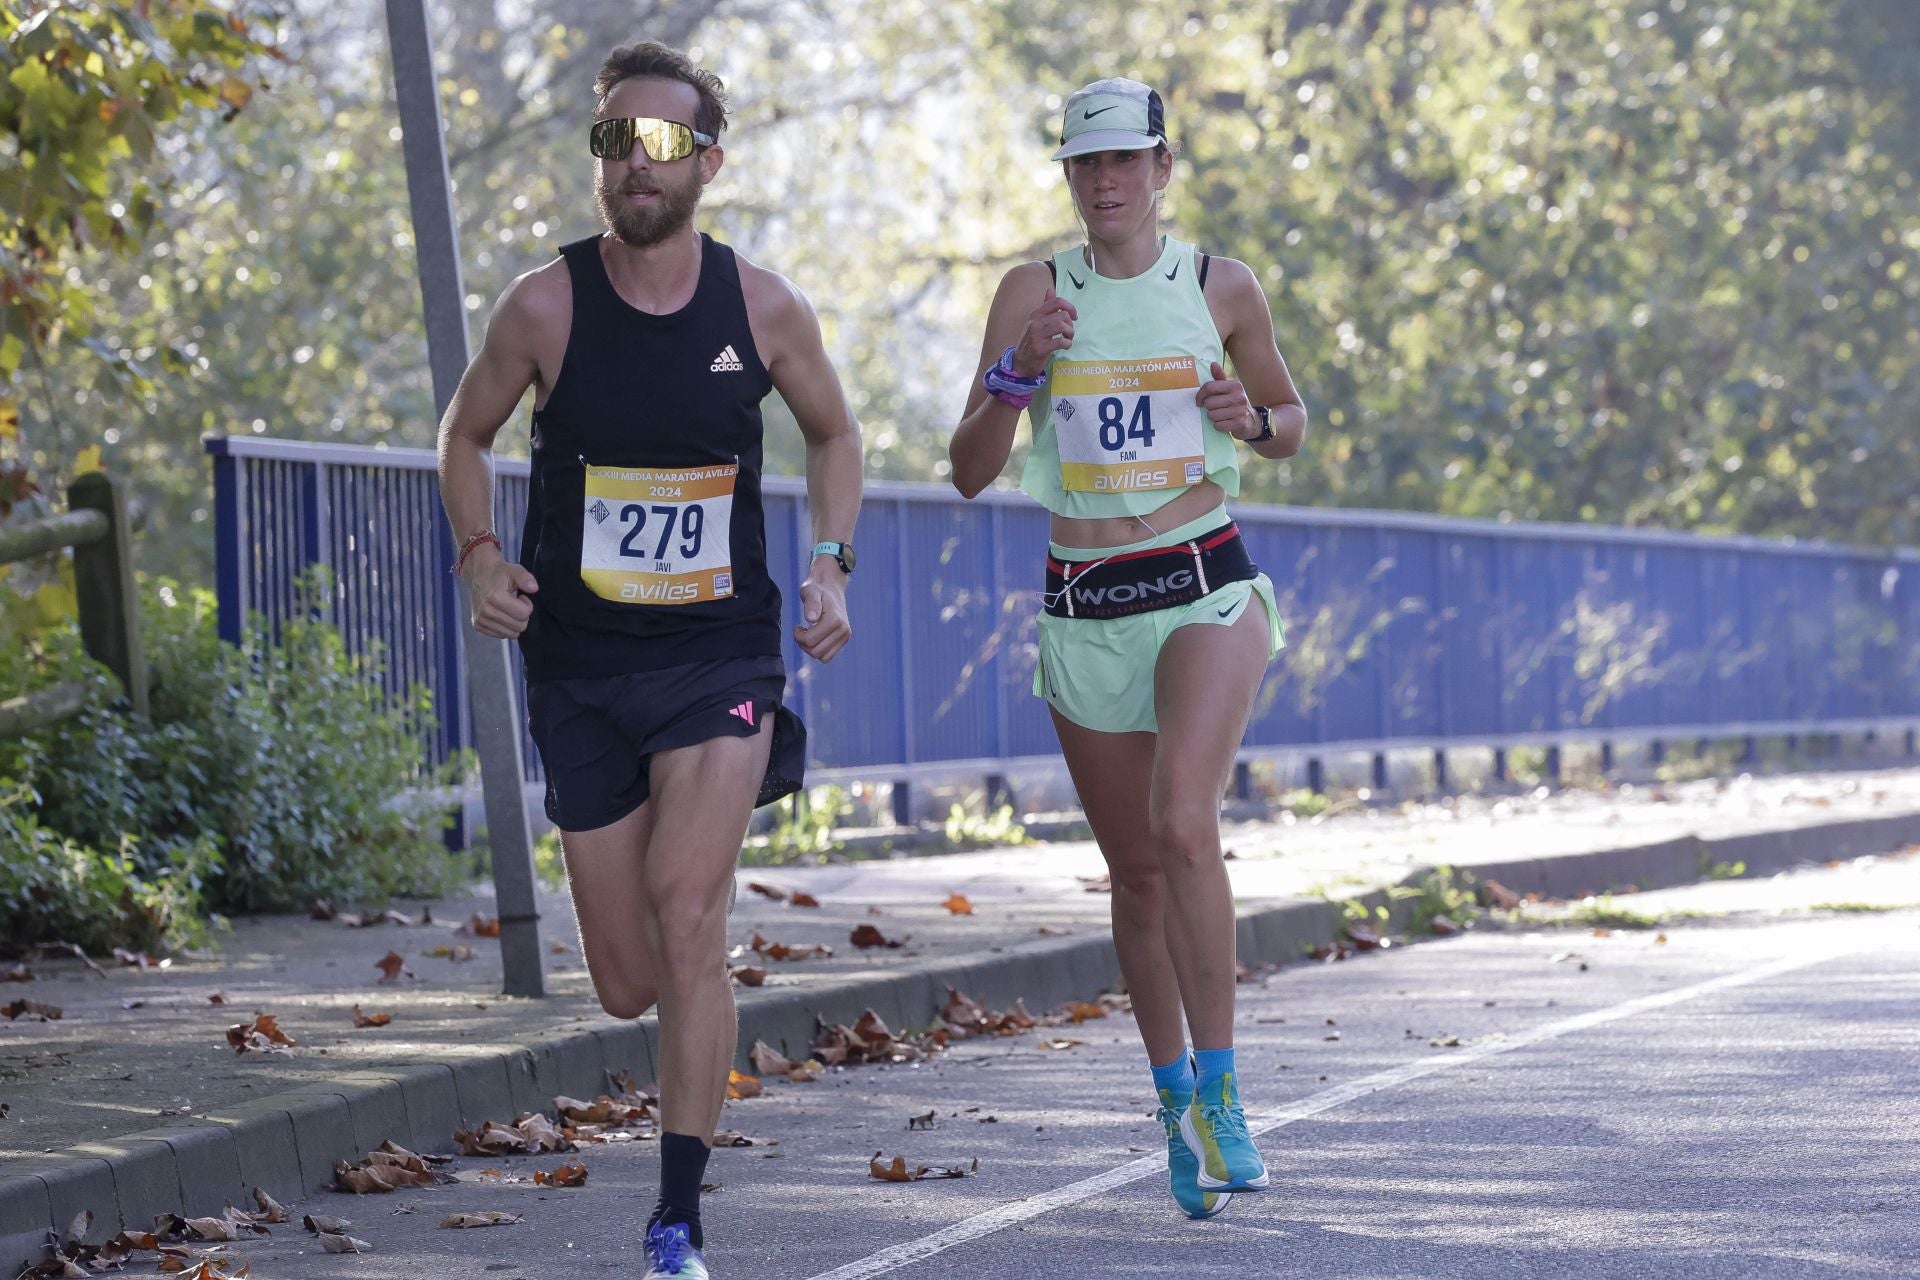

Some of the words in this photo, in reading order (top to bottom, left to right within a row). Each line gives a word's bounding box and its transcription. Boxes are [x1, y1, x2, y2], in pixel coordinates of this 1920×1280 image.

[711, 361, 744, 372] adidas
[1056, 367, 1080, 376] XXXIII
[1083, 365, 1111, 375] MEDIA
[1114, 360, 1162, 373] MARATÓN
[1164, 358, 1193, 370] AVILÉS
[1108, 377, 1140, 388] 2024
[1098, 395, 1156, 451] 84
[1120, 450, 1137, 462] FANI
[621, 472, 652, 480] MEDIA
[655, 470, 703, 482] MARATÓN
[705, 466, 735, 479] AVILÉS
[1095, 469, 1168, 489] avilés
[649, 486, 682, 497] 2024
[619, 503, 704, 560] 279
[655, 561, 672, 573] JAVI
[620, 580, 698, 600] avilés
[1074, 569, 1193, 605] WONG
